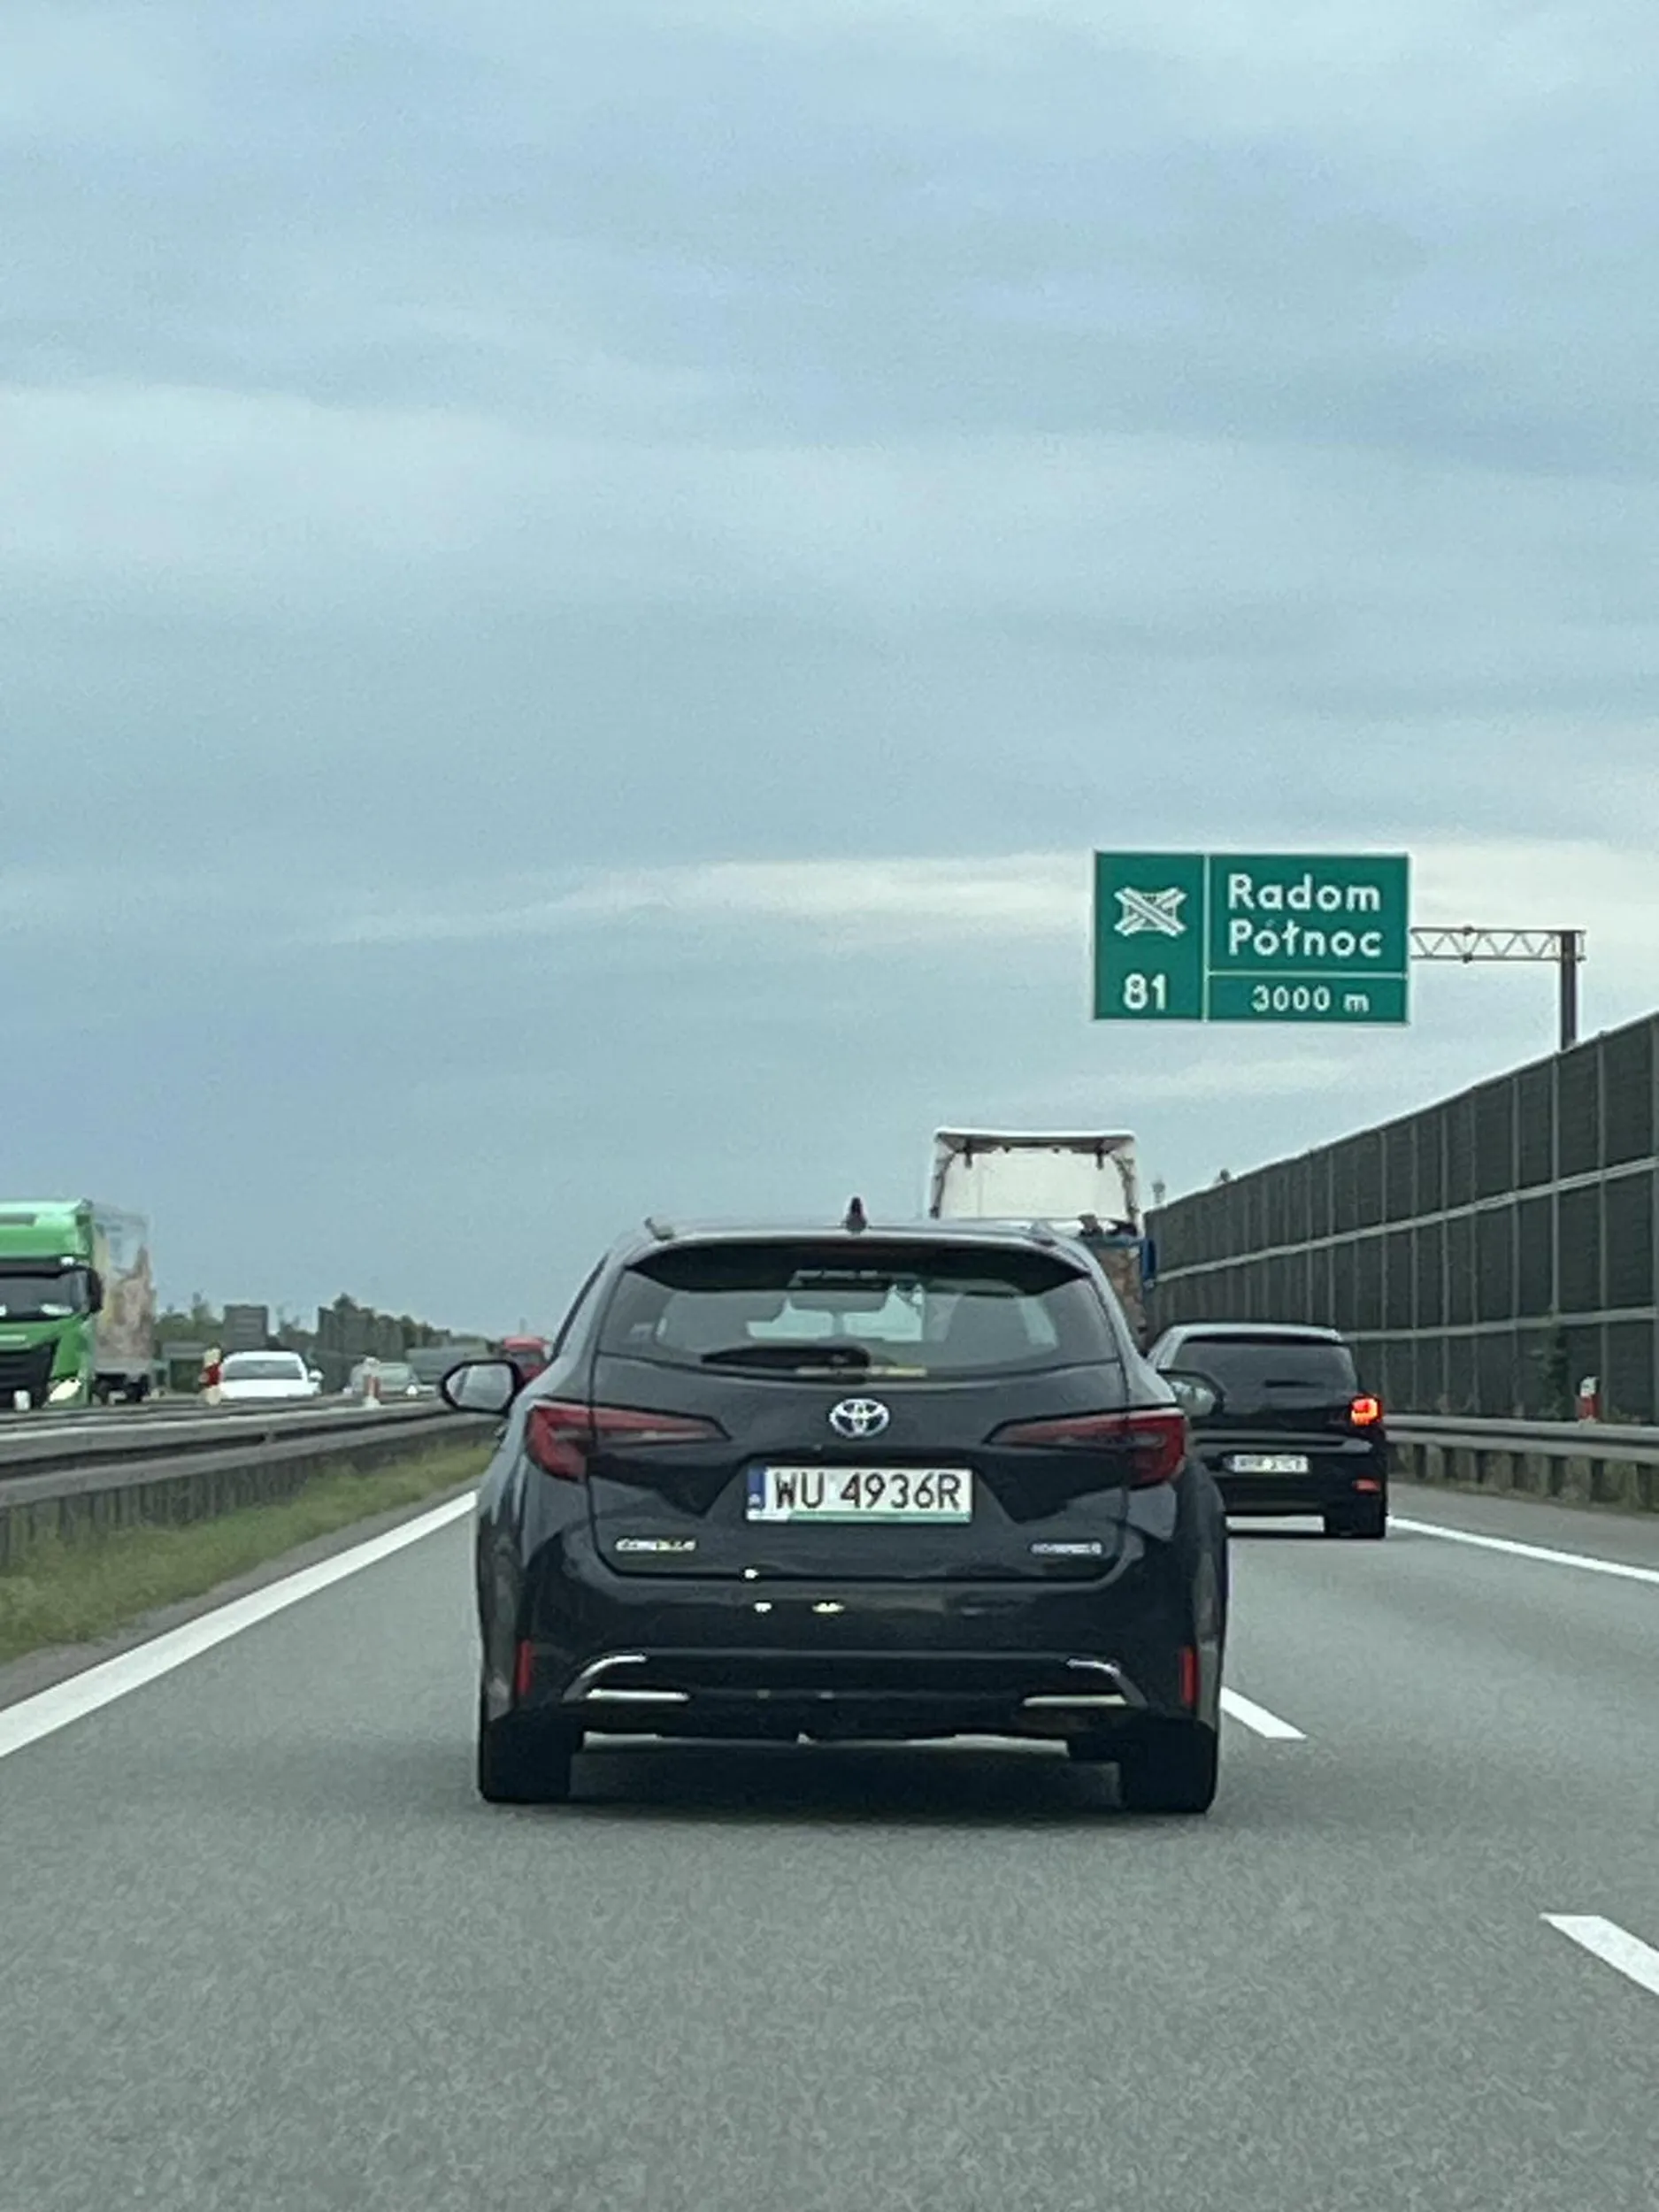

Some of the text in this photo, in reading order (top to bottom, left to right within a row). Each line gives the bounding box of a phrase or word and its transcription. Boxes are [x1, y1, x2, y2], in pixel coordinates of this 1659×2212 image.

[1228, 873, 1380, 910] Radom
[1228, 918, 1383, 957] Północ
[1123, 973, 1166, 1010] 81
[1251, 986, 1370, 1012] 3000 m
[774, 1471, 961, 1509] WU 4936R
